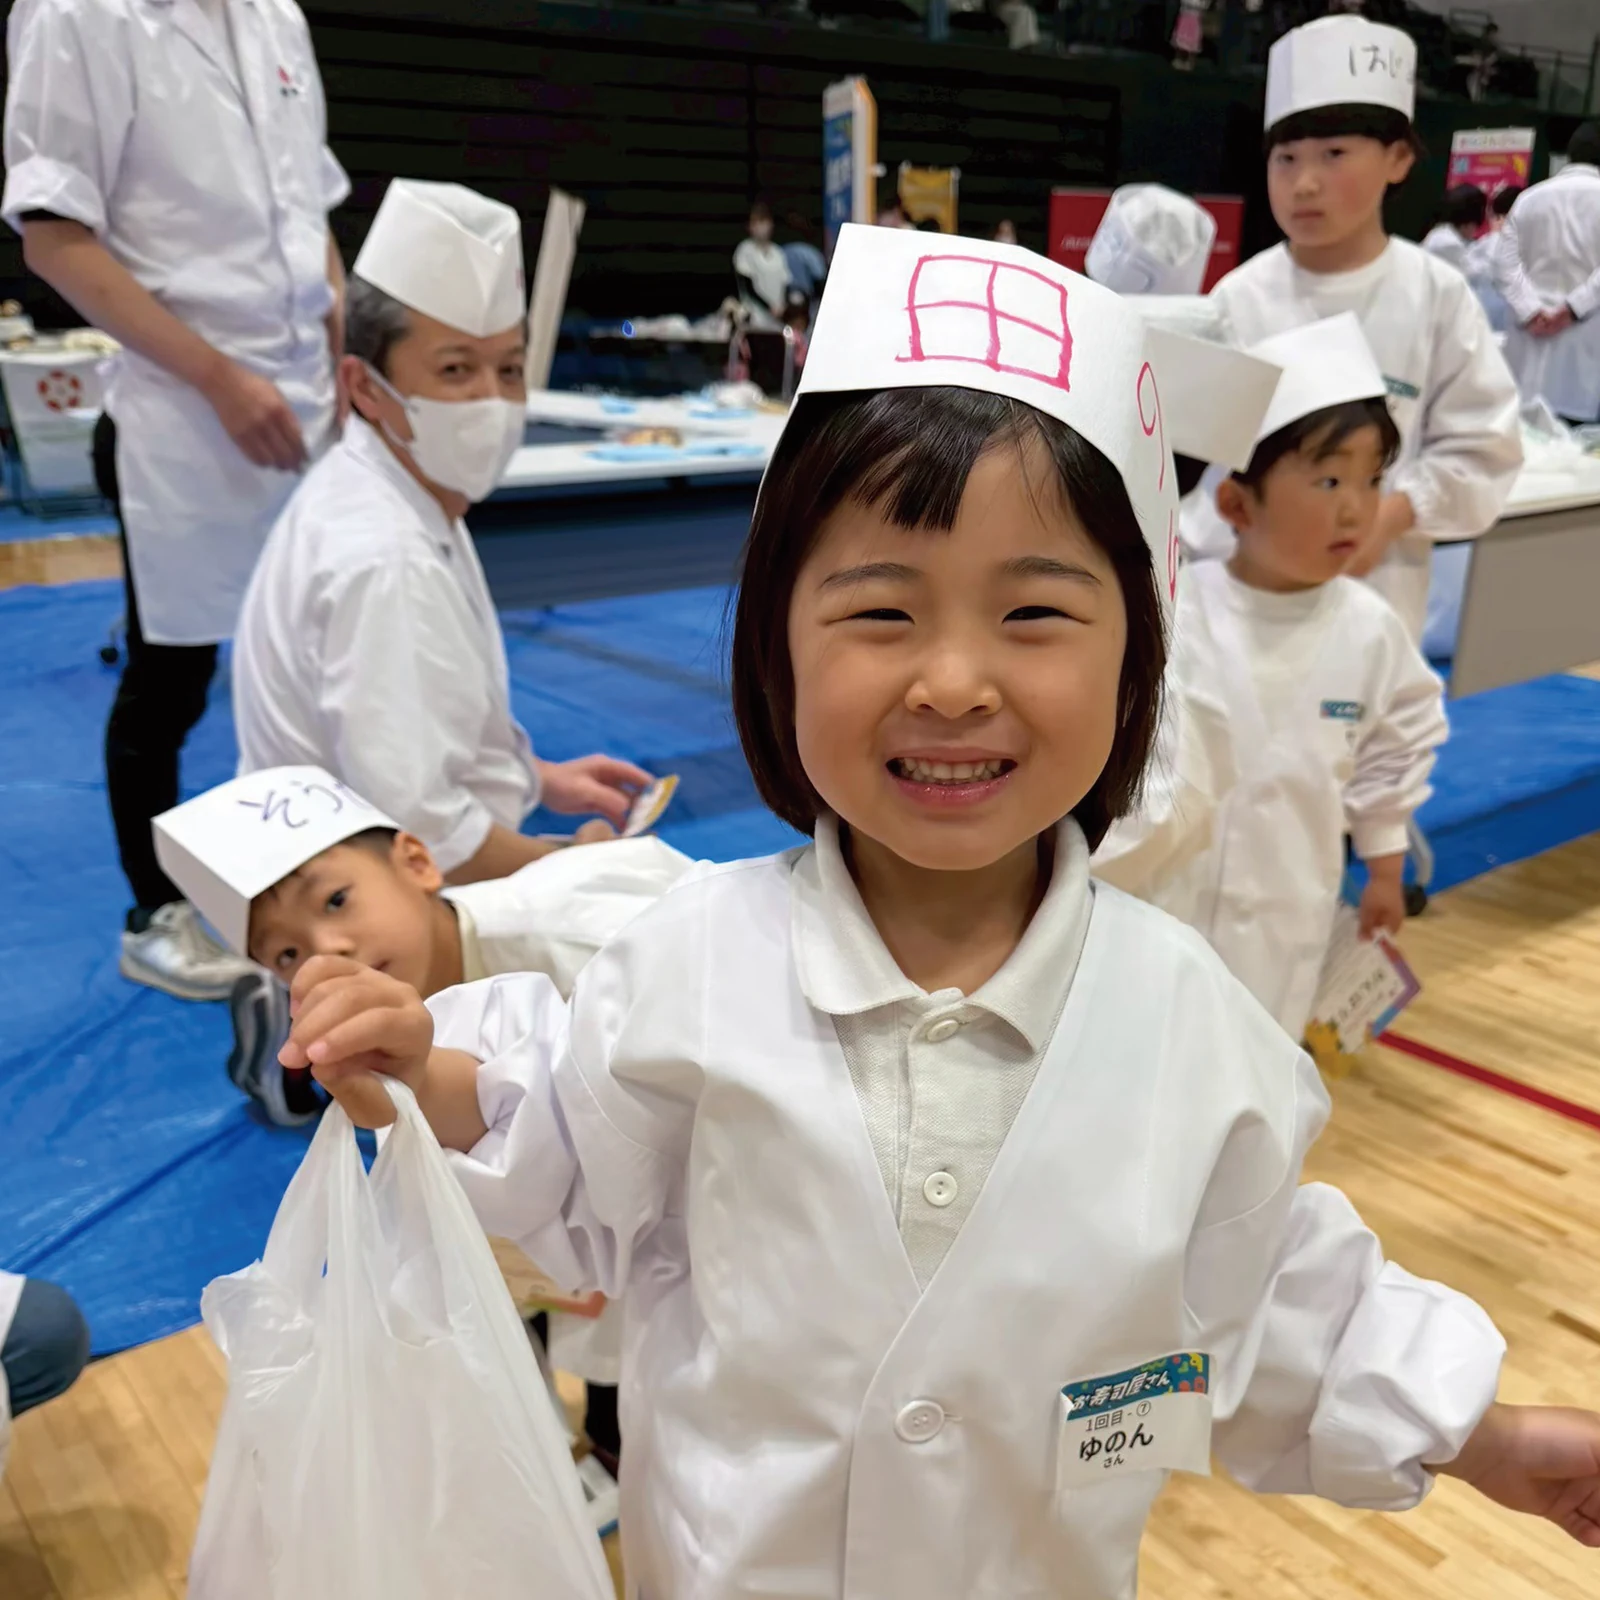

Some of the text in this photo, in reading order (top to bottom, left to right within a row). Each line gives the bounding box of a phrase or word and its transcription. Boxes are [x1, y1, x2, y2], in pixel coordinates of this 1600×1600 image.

[1348, 44, 1416, 85] はじ
[236, 780, 372, 829] そう
[1072, 1370, 1171, 1411] お寿司屋さん
[1079, 1422, 1154, 1462] ゆのん
[1103, 1453, 1125, 1469] さん
